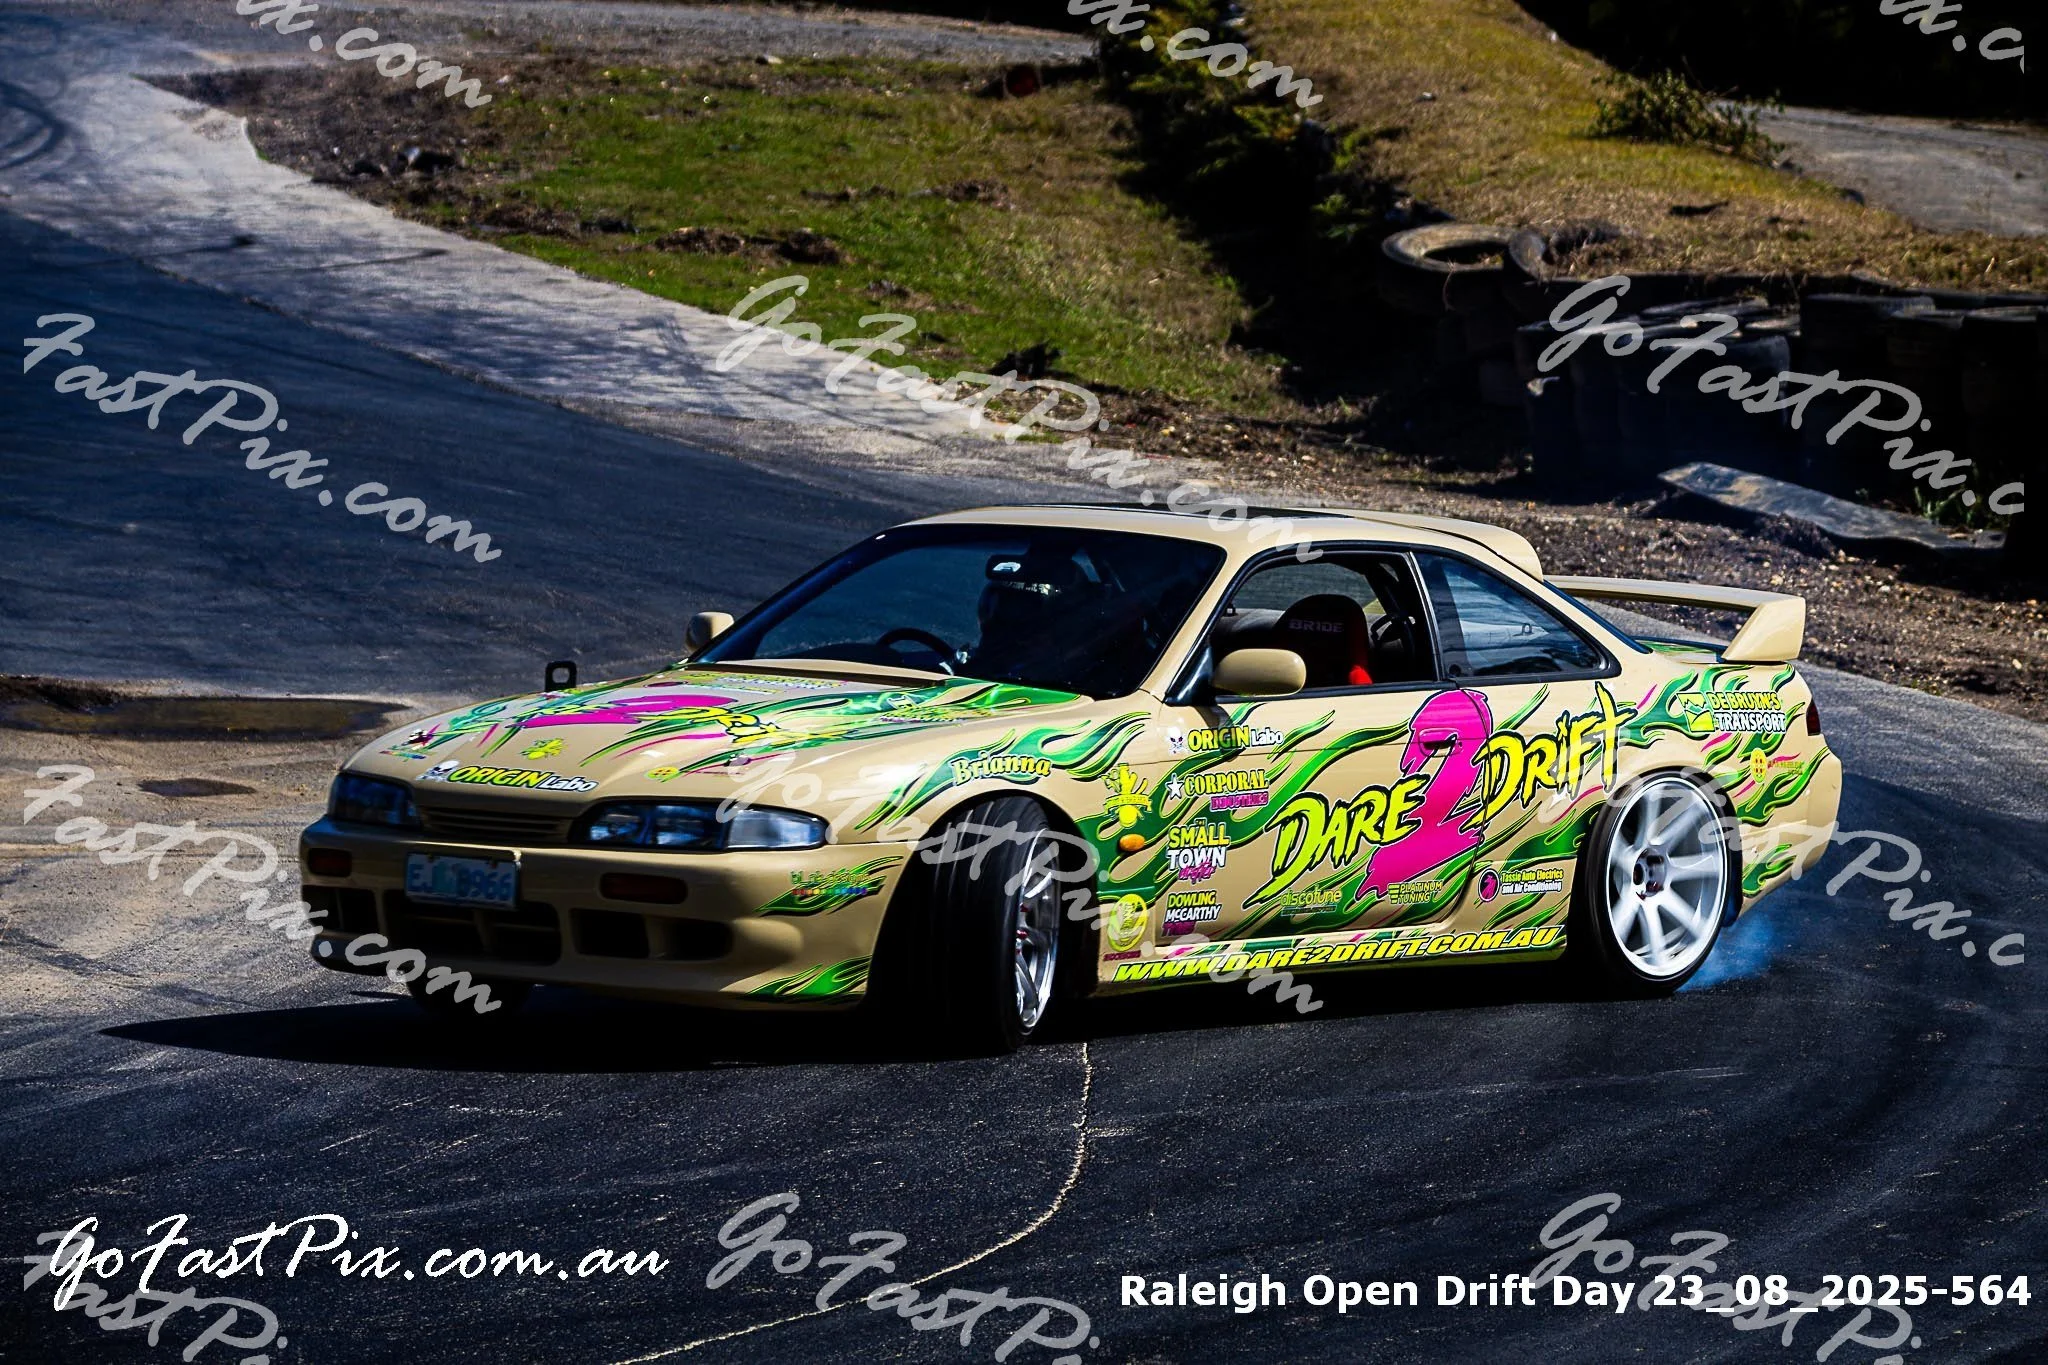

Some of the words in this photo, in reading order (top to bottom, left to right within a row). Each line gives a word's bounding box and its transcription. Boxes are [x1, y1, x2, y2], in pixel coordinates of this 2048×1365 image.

[1289, 619, 1344, 633] BRIDE
[1706, 692, 1729, 710] DE
[1716, 711, 1787, 732] TRANSPORT
[1188, 726, 1250, 751] ORIGIN
[1251, 727, 1284, 747] Labo
[449, 766, 553, 788] ORIGIN
[537, 776, 599, 792] Labo
[951, 751, 1051, 786] Brianna
[1184, 769, 1269, 796] CORPORAL
[1244, 774, 1430, 910] DARE
[1357, 688, 1493, 901] 2
[1168, 823, 1230, 848] SMALL
[1167, 847, 1227, 871] TOWN
[1522, 870, 1536, 882] Auto
[1537, 868, 1563, 881] Electrics
[1280, 885, 1342, 906] discotune
[1400, 880, 1443, 894] PLATINUM
[1168, 890, 1217, 909] DOWLING
[1398, 892, 1431, 905] TUNING
[1111, 924, 1566, 983] WWW.DARE2DRIFT.COM.AU
